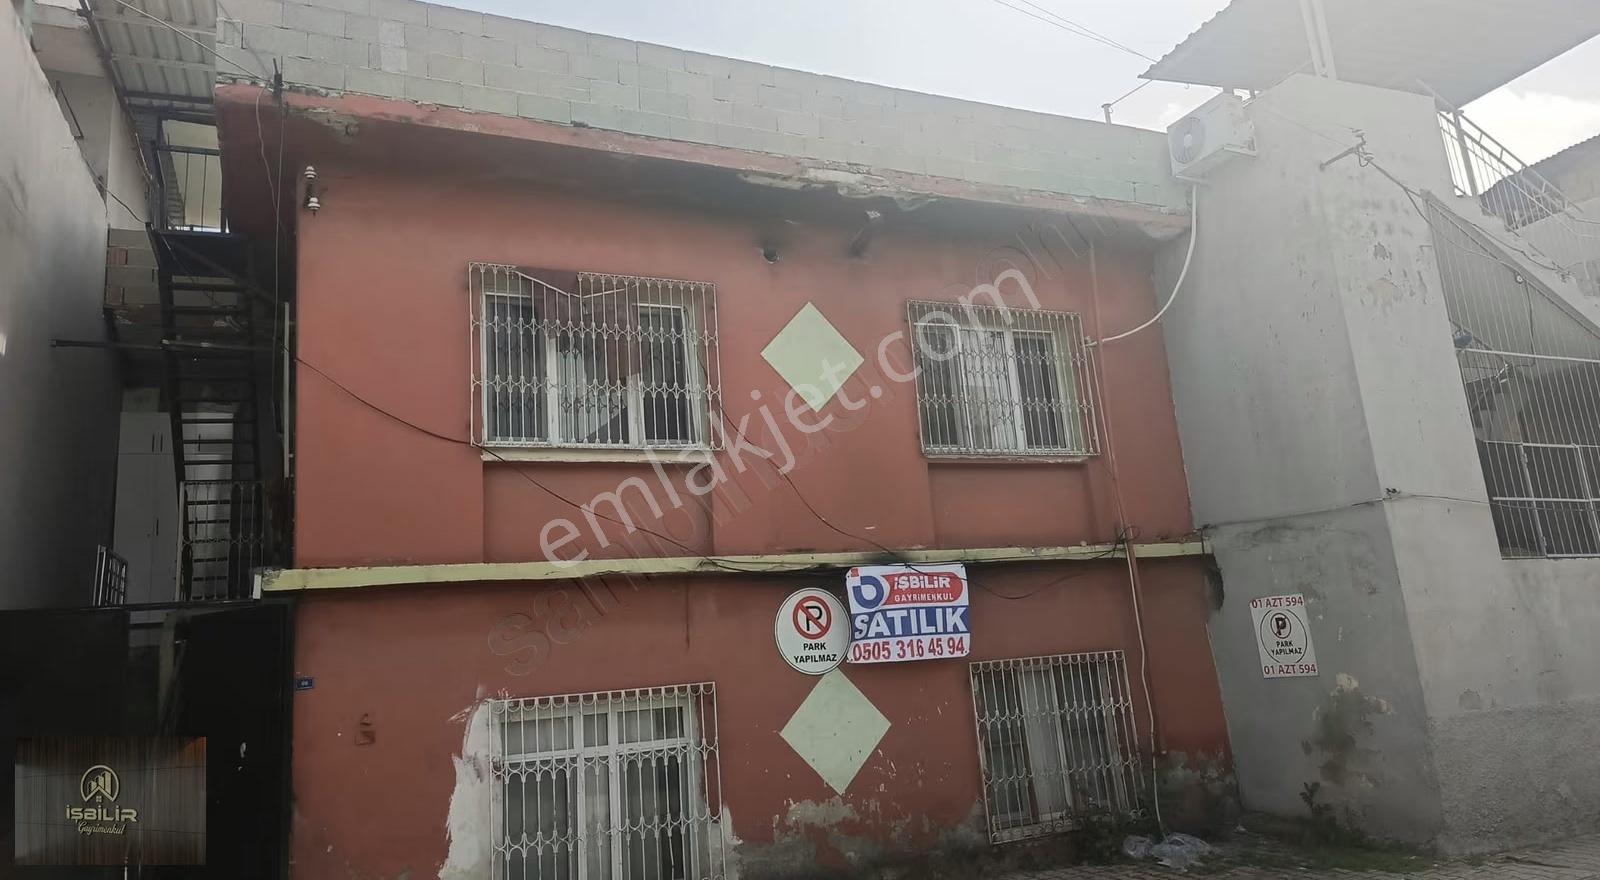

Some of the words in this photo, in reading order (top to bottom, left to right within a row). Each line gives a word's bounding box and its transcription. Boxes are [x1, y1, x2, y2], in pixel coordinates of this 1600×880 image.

[1251, 599, 1262, 608] 01
[1265, 598, 1283, 608] AZT
[1286, 596, 1304, 607] 594
[854, 607, 968, 640] SATILIK
[803, 642, 827, 651] PARK
[853, 641, 892, 661] 0505
[896, 639, 925, 659] 316
[928, 637, 944, 656] 45
[947, 636, 965, 655] 94
[1276, 640, 1293, 648] PARK
[1271, 647, 1303, 656] YAPILMAZ
[794, 653, 838, 664] YAPILMAZ
[1263, 665, 1275, 675] 01
[1278, 664, 1296, 674] AZT
[1300, 663, 1317, 674] 594
